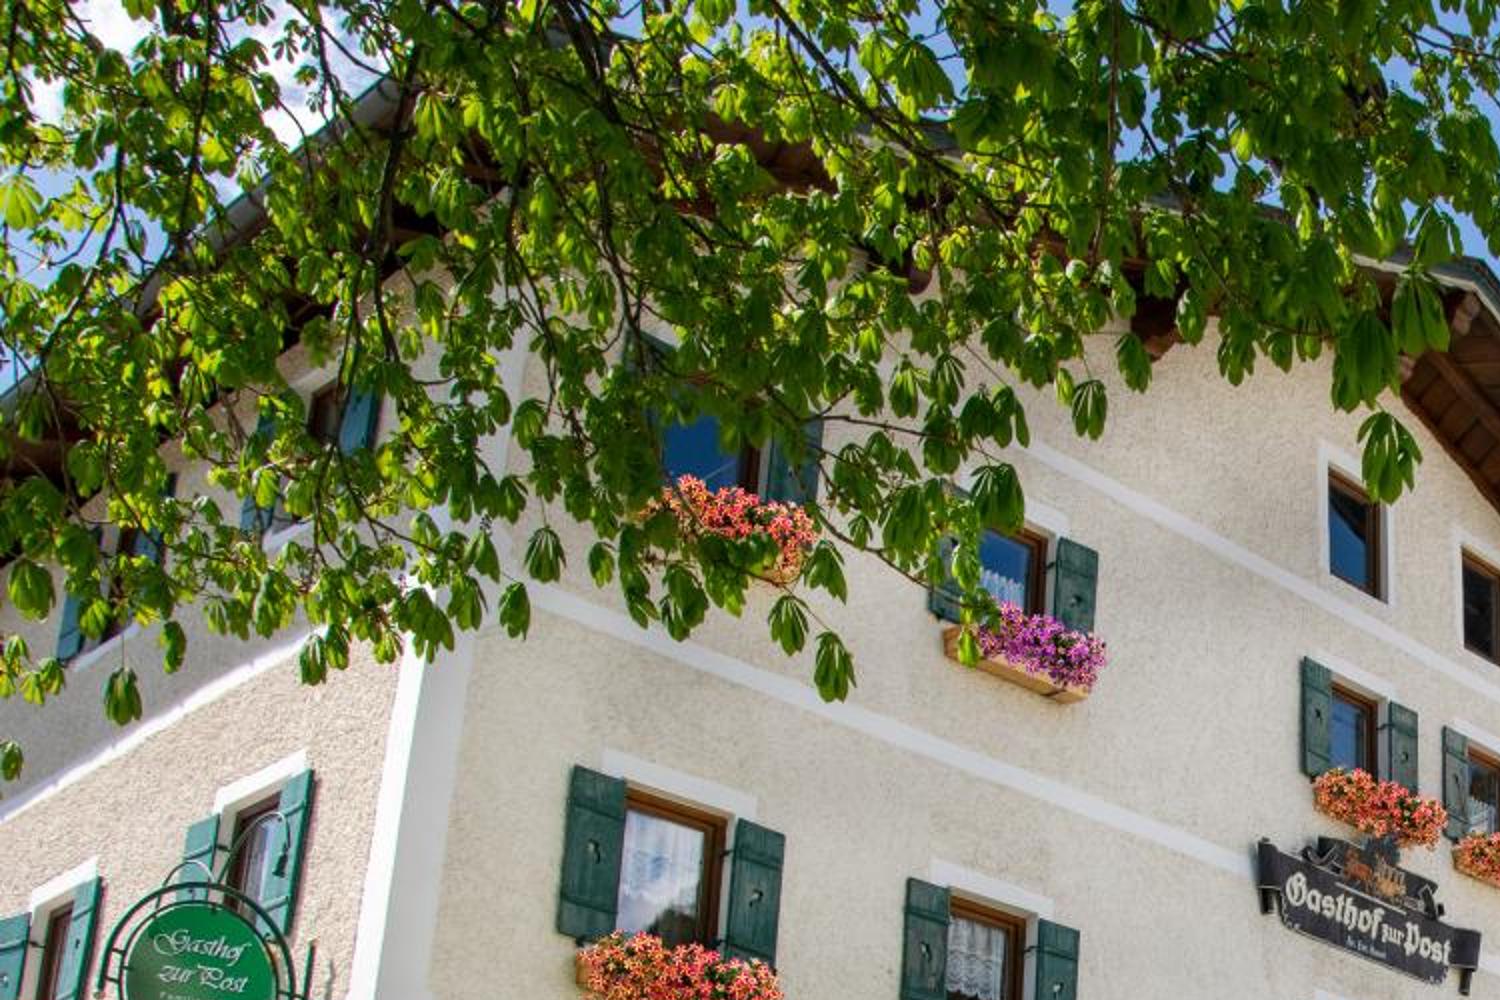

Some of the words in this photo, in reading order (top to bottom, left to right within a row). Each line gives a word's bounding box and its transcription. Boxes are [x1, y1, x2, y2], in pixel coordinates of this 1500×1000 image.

[1285, 872, 1385, 940] Gasthof
[1381, 923, 1404, 945] zur
[1404, 921, 1452, 966] Post
[153, 929, 253, 967] Gasthof
[196, 964, 249, 993] Post
